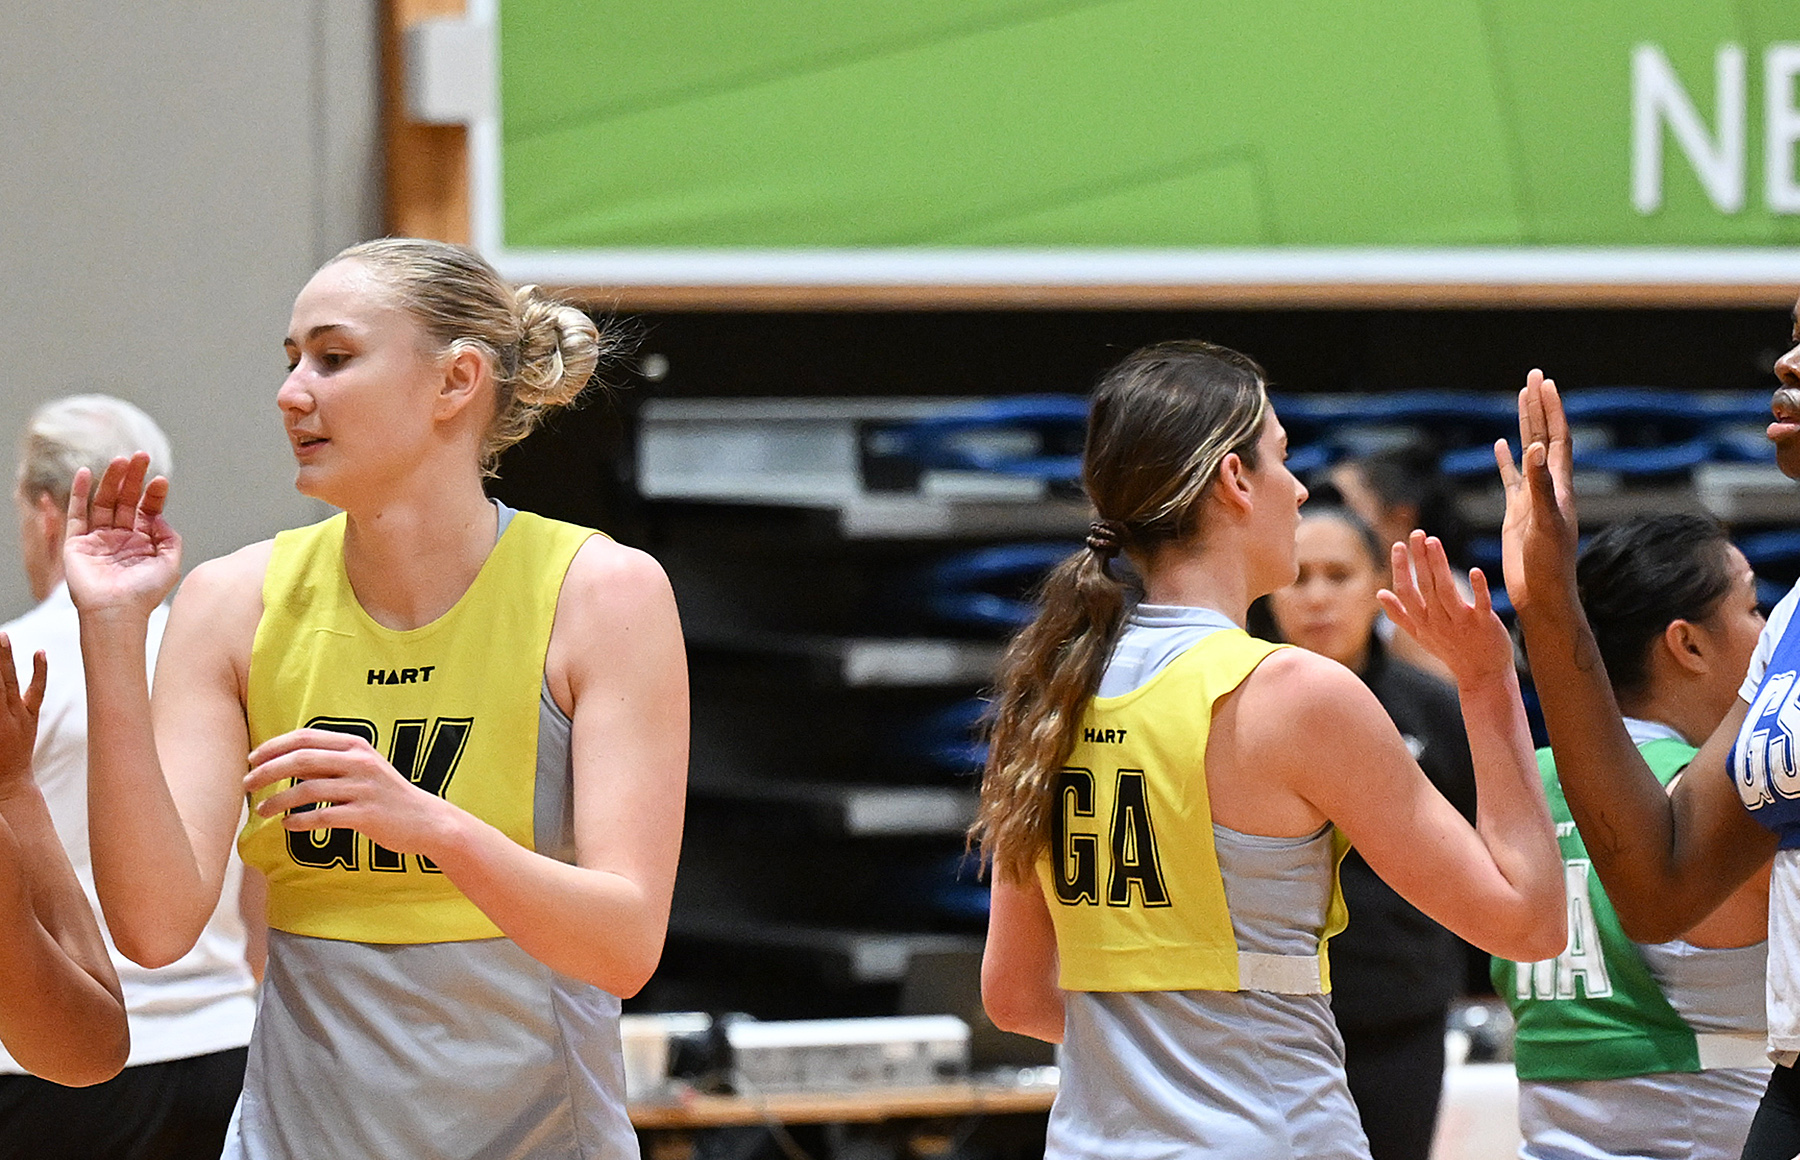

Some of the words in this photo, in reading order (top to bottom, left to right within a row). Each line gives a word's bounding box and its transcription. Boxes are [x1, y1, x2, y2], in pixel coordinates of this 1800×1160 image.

[367, 666, 435, 685] HART
[1084, 728, 1127, 744] HART
[1050, 766, 1172, 907] GA
[1516, 858, 1613, 1000] A
